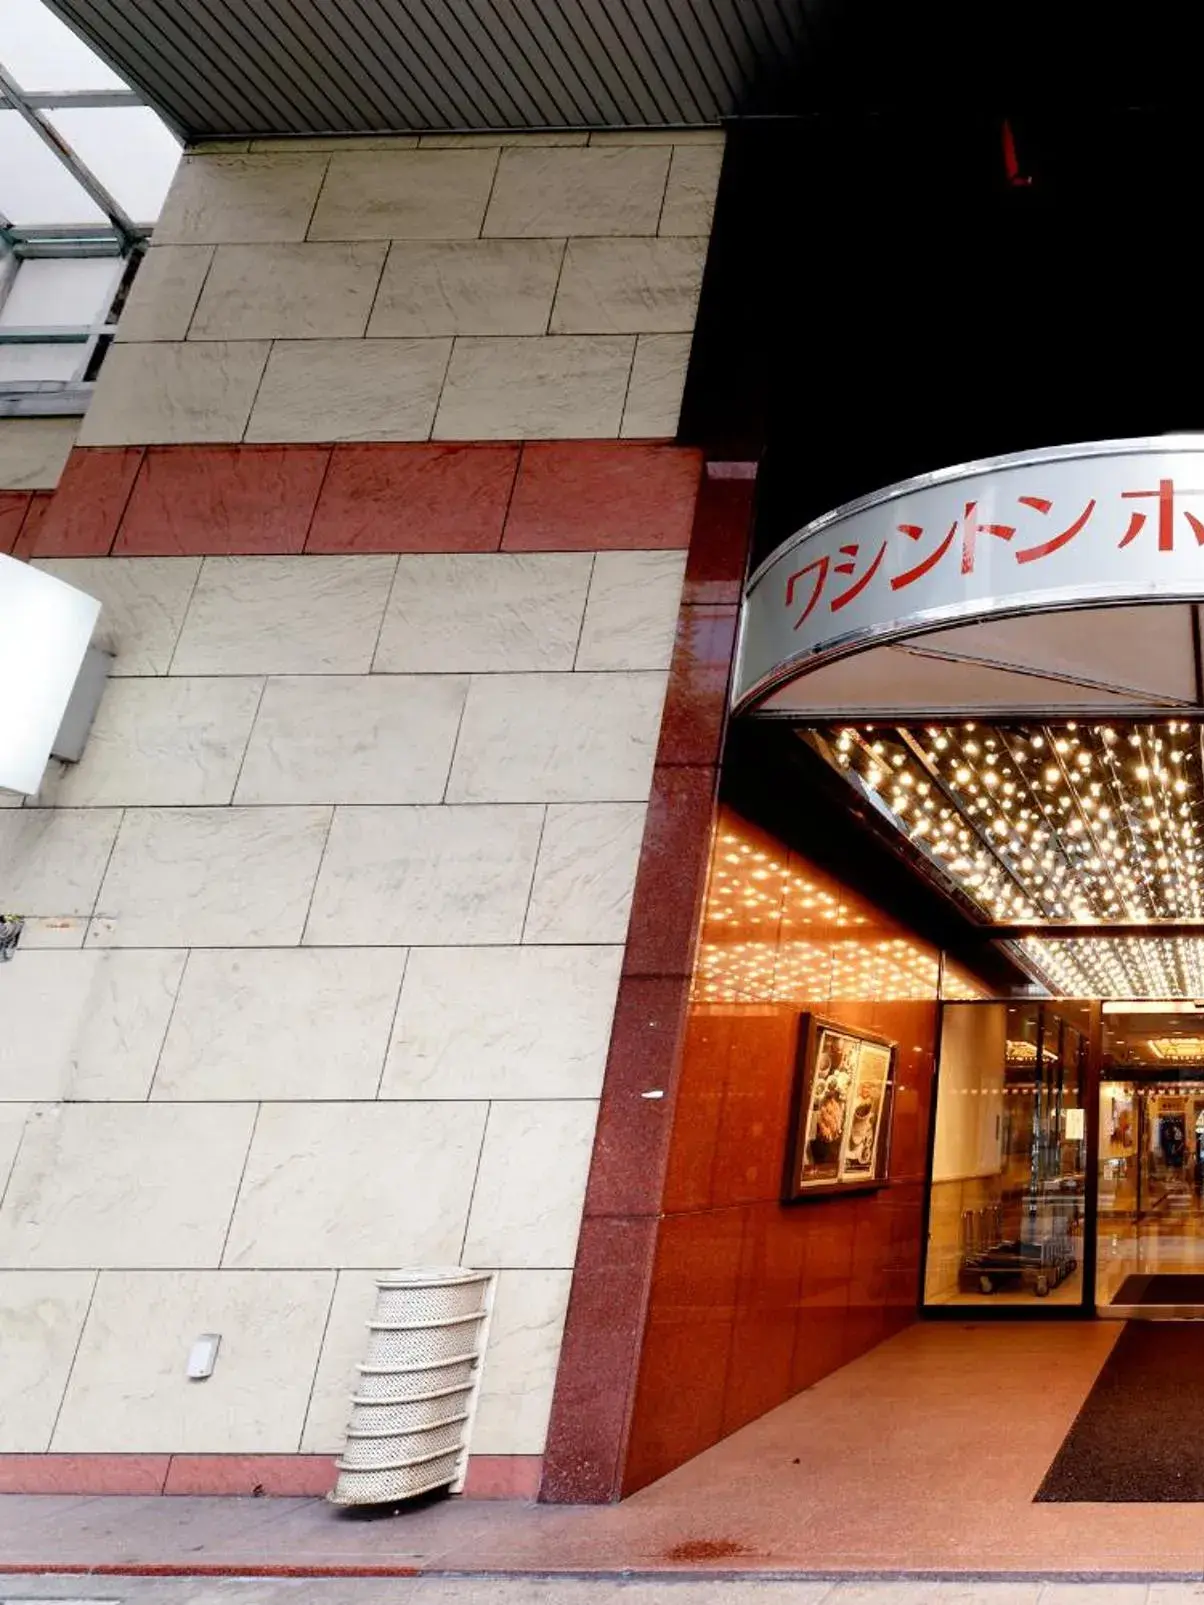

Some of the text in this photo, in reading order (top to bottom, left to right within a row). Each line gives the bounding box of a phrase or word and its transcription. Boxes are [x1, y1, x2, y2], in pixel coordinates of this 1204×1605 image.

[786, 496, 1096, 631] ワシントン
